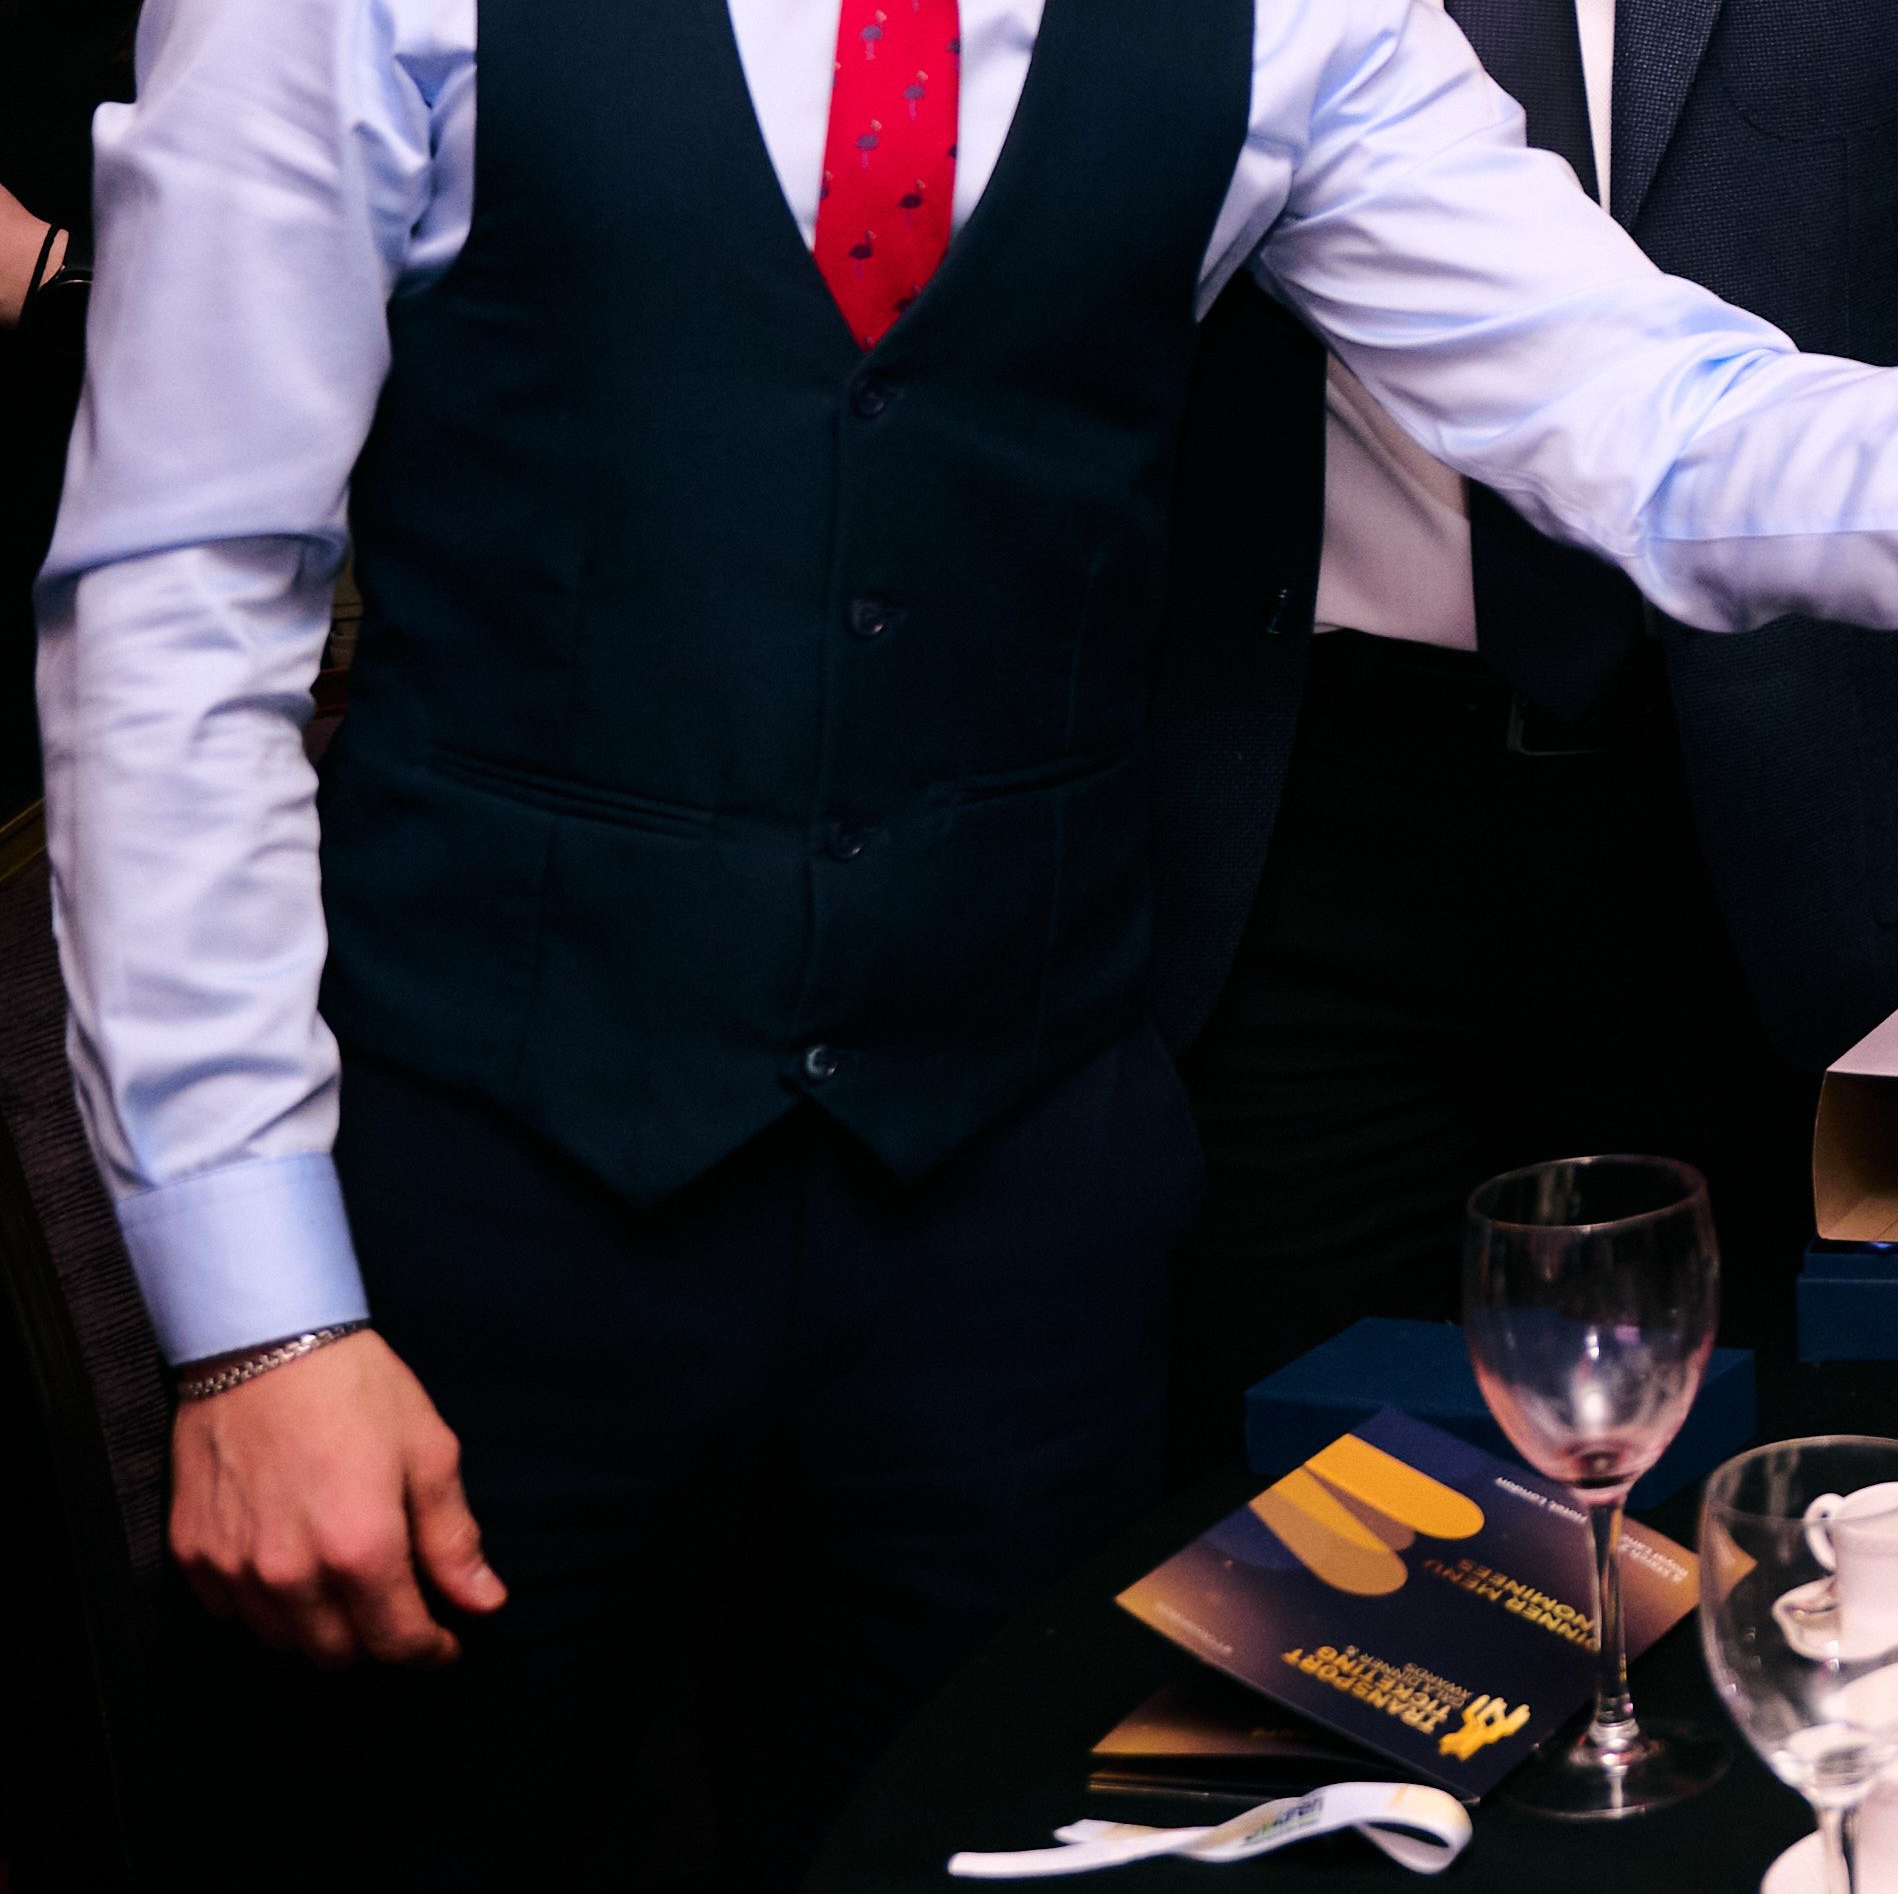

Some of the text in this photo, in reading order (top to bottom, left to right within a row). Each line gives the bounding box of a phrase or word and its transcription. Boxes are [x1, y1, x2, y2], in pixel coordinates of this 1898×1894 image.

[1494, 1477, 1548, 1505] London
[1421, 1558, 1503, 1603] MENU
[1456, 1557, 1596, 1633] NOMINEES
[1281, 1648, 1440, 1736] TRANSPORT
[1315, 1645, 1452, 1724] TICKETING
